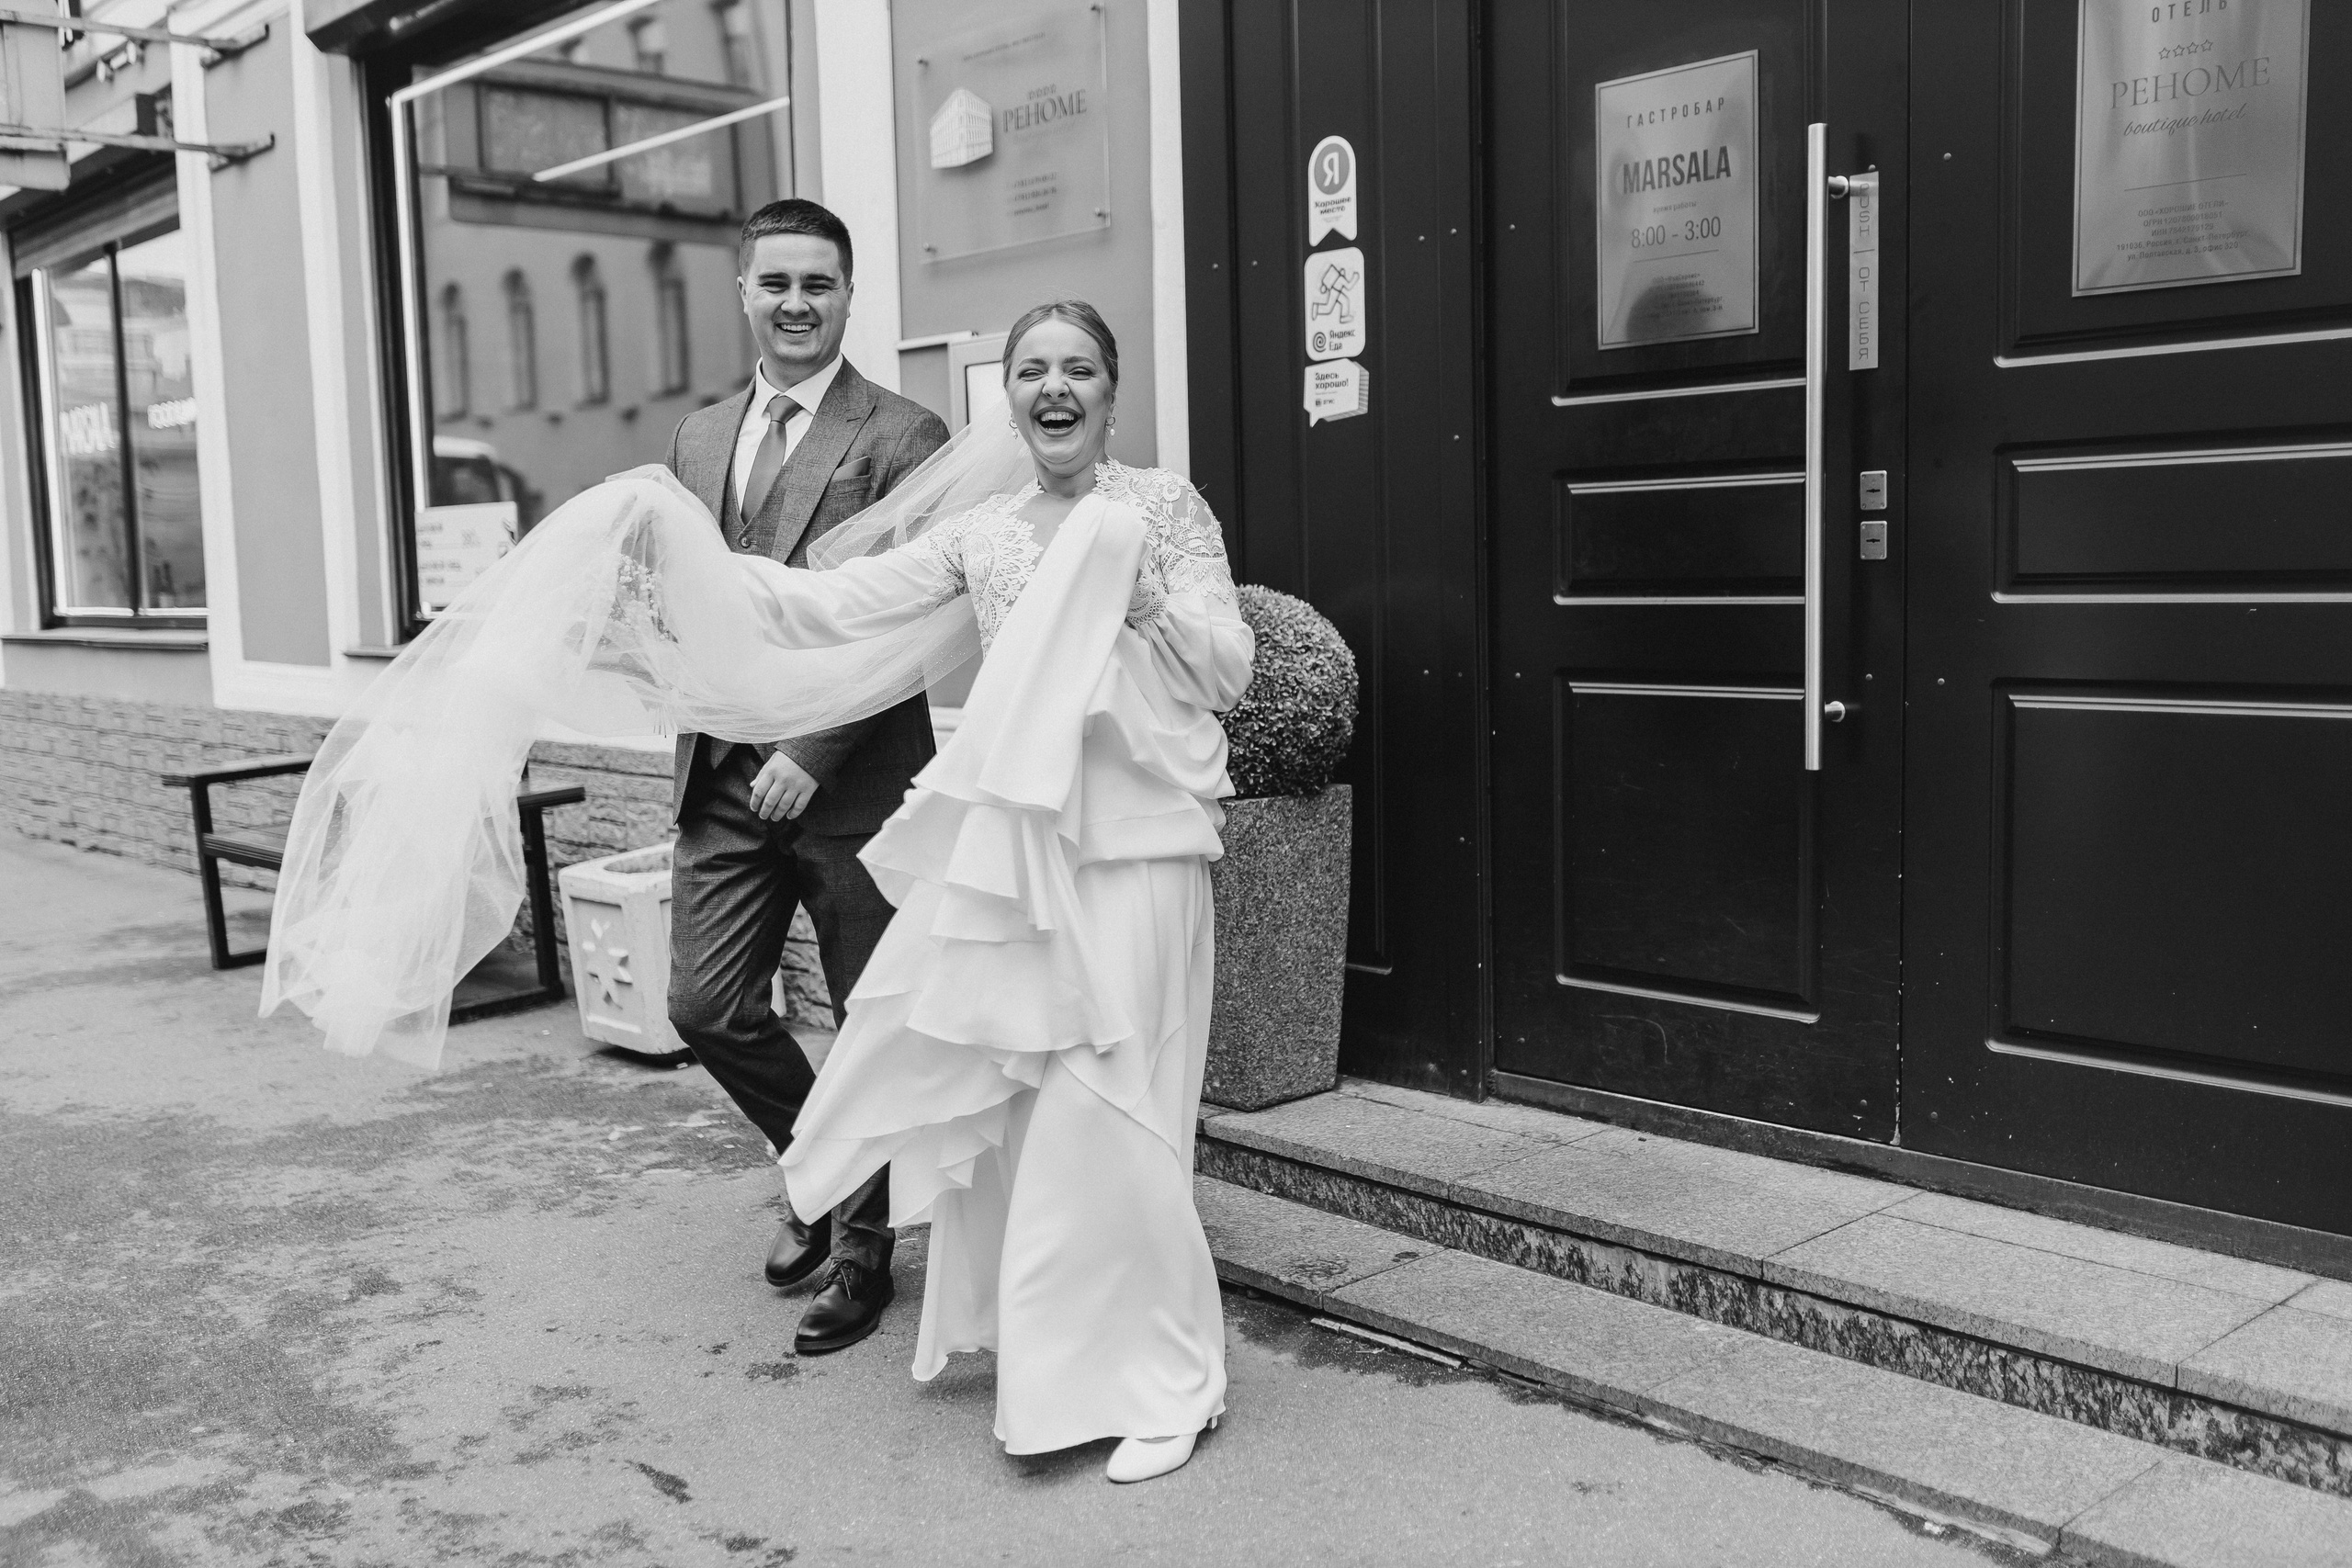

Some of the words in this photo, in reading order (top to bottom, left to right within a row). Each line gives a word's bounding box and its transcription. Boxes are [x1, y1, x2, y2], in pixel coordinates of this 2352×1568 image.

[1627, 96, 1724, 128] ГАСТРОБАР
[2123, 115, 2199, 136] boutique
[2199, 103, 2247, 125] hotel
[1623, 145, 1732, 194] MARSALA
[1315, 197, 1351, 209] Хорошее
[1859, 183, 1871, 237] PUSH
[2138, 209, 2154, 217] ООО
[2143, 219, 2163, 227] ОГРН
[1632, 224, 1666, 248] 8:00
[1685, 216, 1721, 241] 3:00
[2151, 228, 2167, 237] ИНН
[1329, 330, 1356, 339] Яндекс
[1329, 342, 1342, 351] Еда
[1315, 372, 1339, 381] Здесь
[1316, 378, 1349, 390] хорошо!
